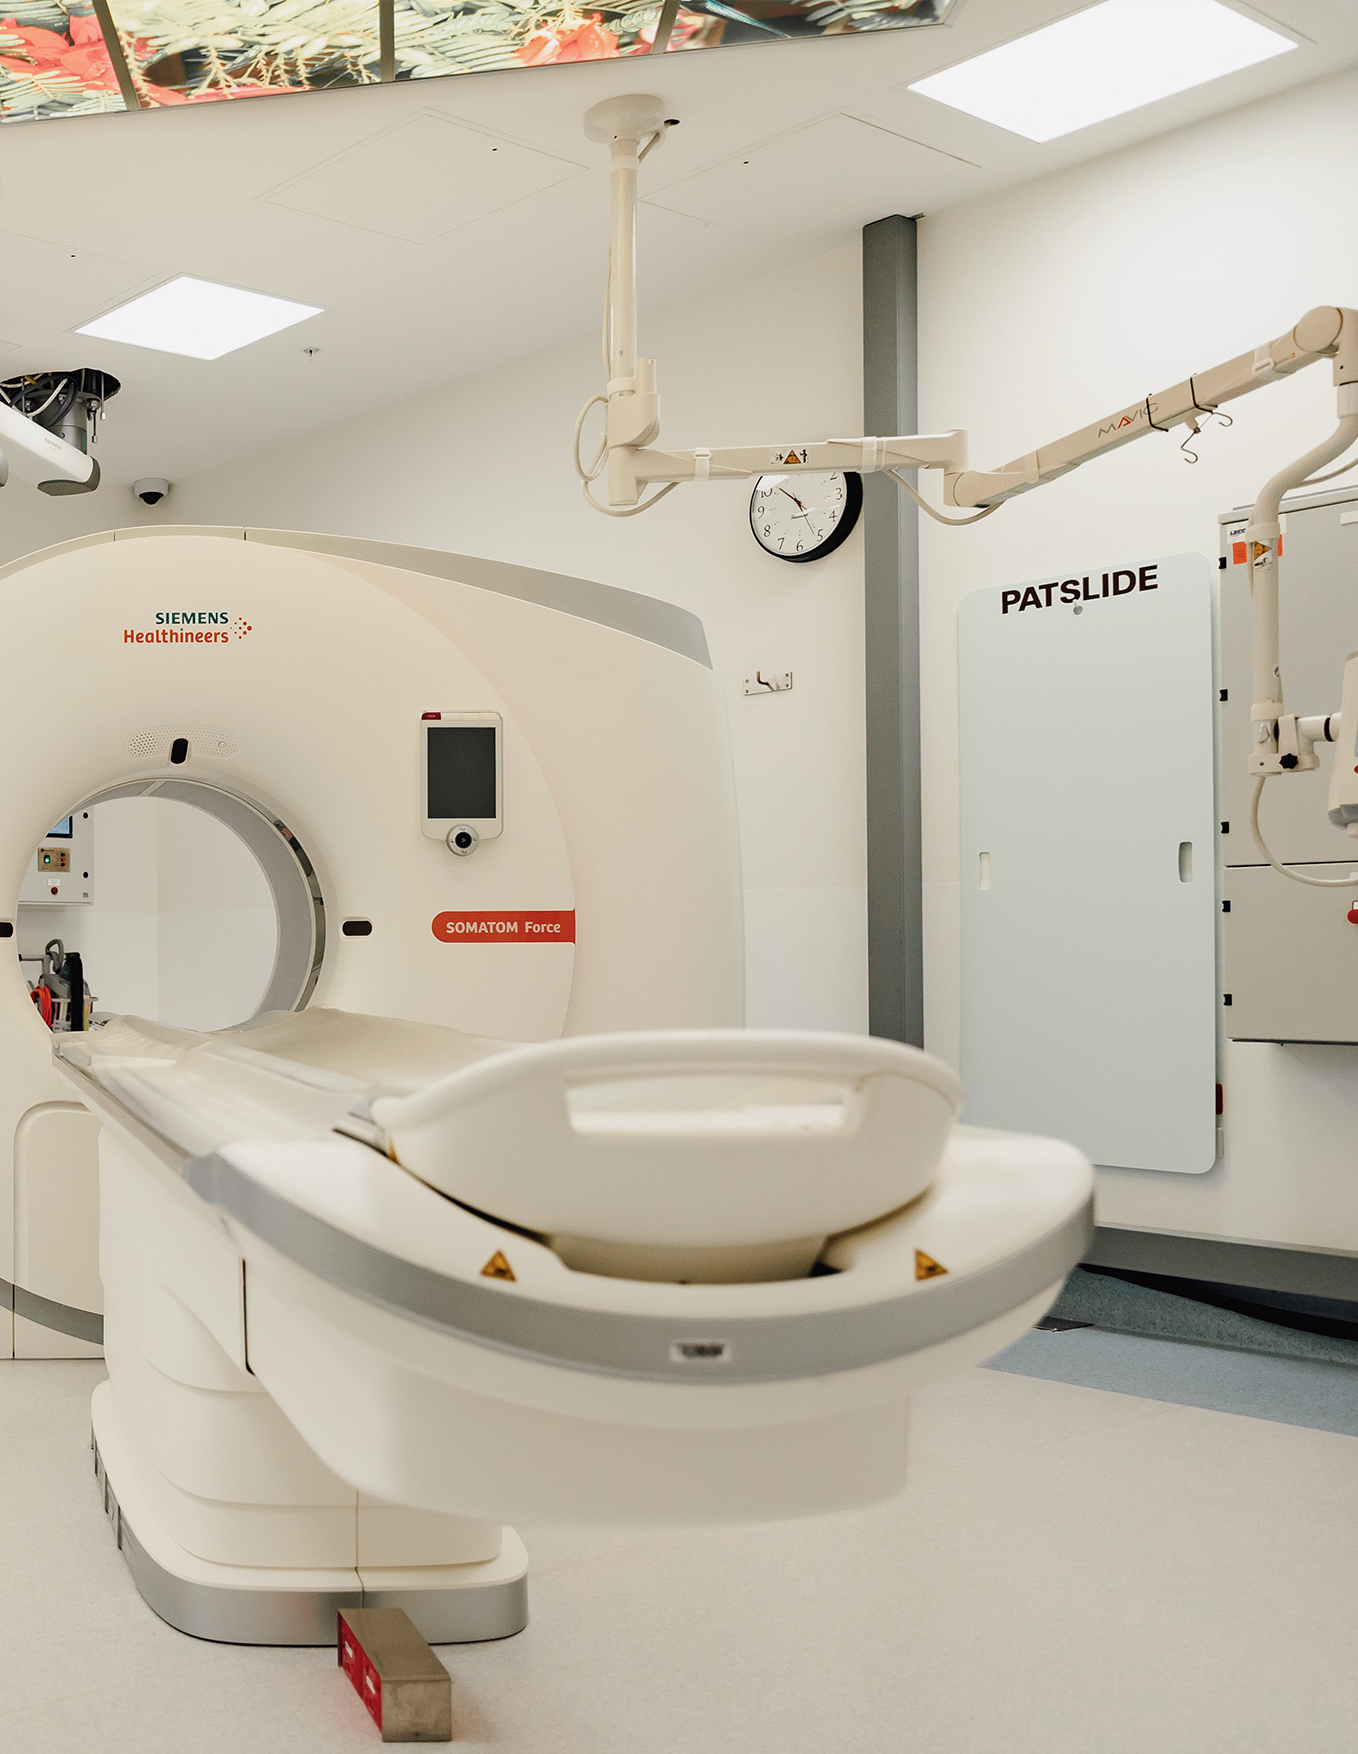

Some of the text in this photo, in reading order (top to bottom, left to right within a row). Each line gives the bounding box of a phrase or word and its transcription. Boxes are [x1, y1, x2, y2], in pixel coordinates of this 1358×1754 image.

[1097, 402, 1159, 438] MAVIG
[835, 487, 843, 500] 3
[757, 505, 765, 519] 9
[828, 510, 838, 522] 4
[763, 524, 771, 537] 8
[816, 529, 824, 542] 5
[777, 537, 785, 550] 7
[796, 539, 804, 551] 6
[1001, 564, 1159, 615] PATSLIDE
[155, 611, 229, 624] SIEMENS
[123, 627, 230, 643] Healthineers
[446, 921, 561, 934] SOMATOM Force
